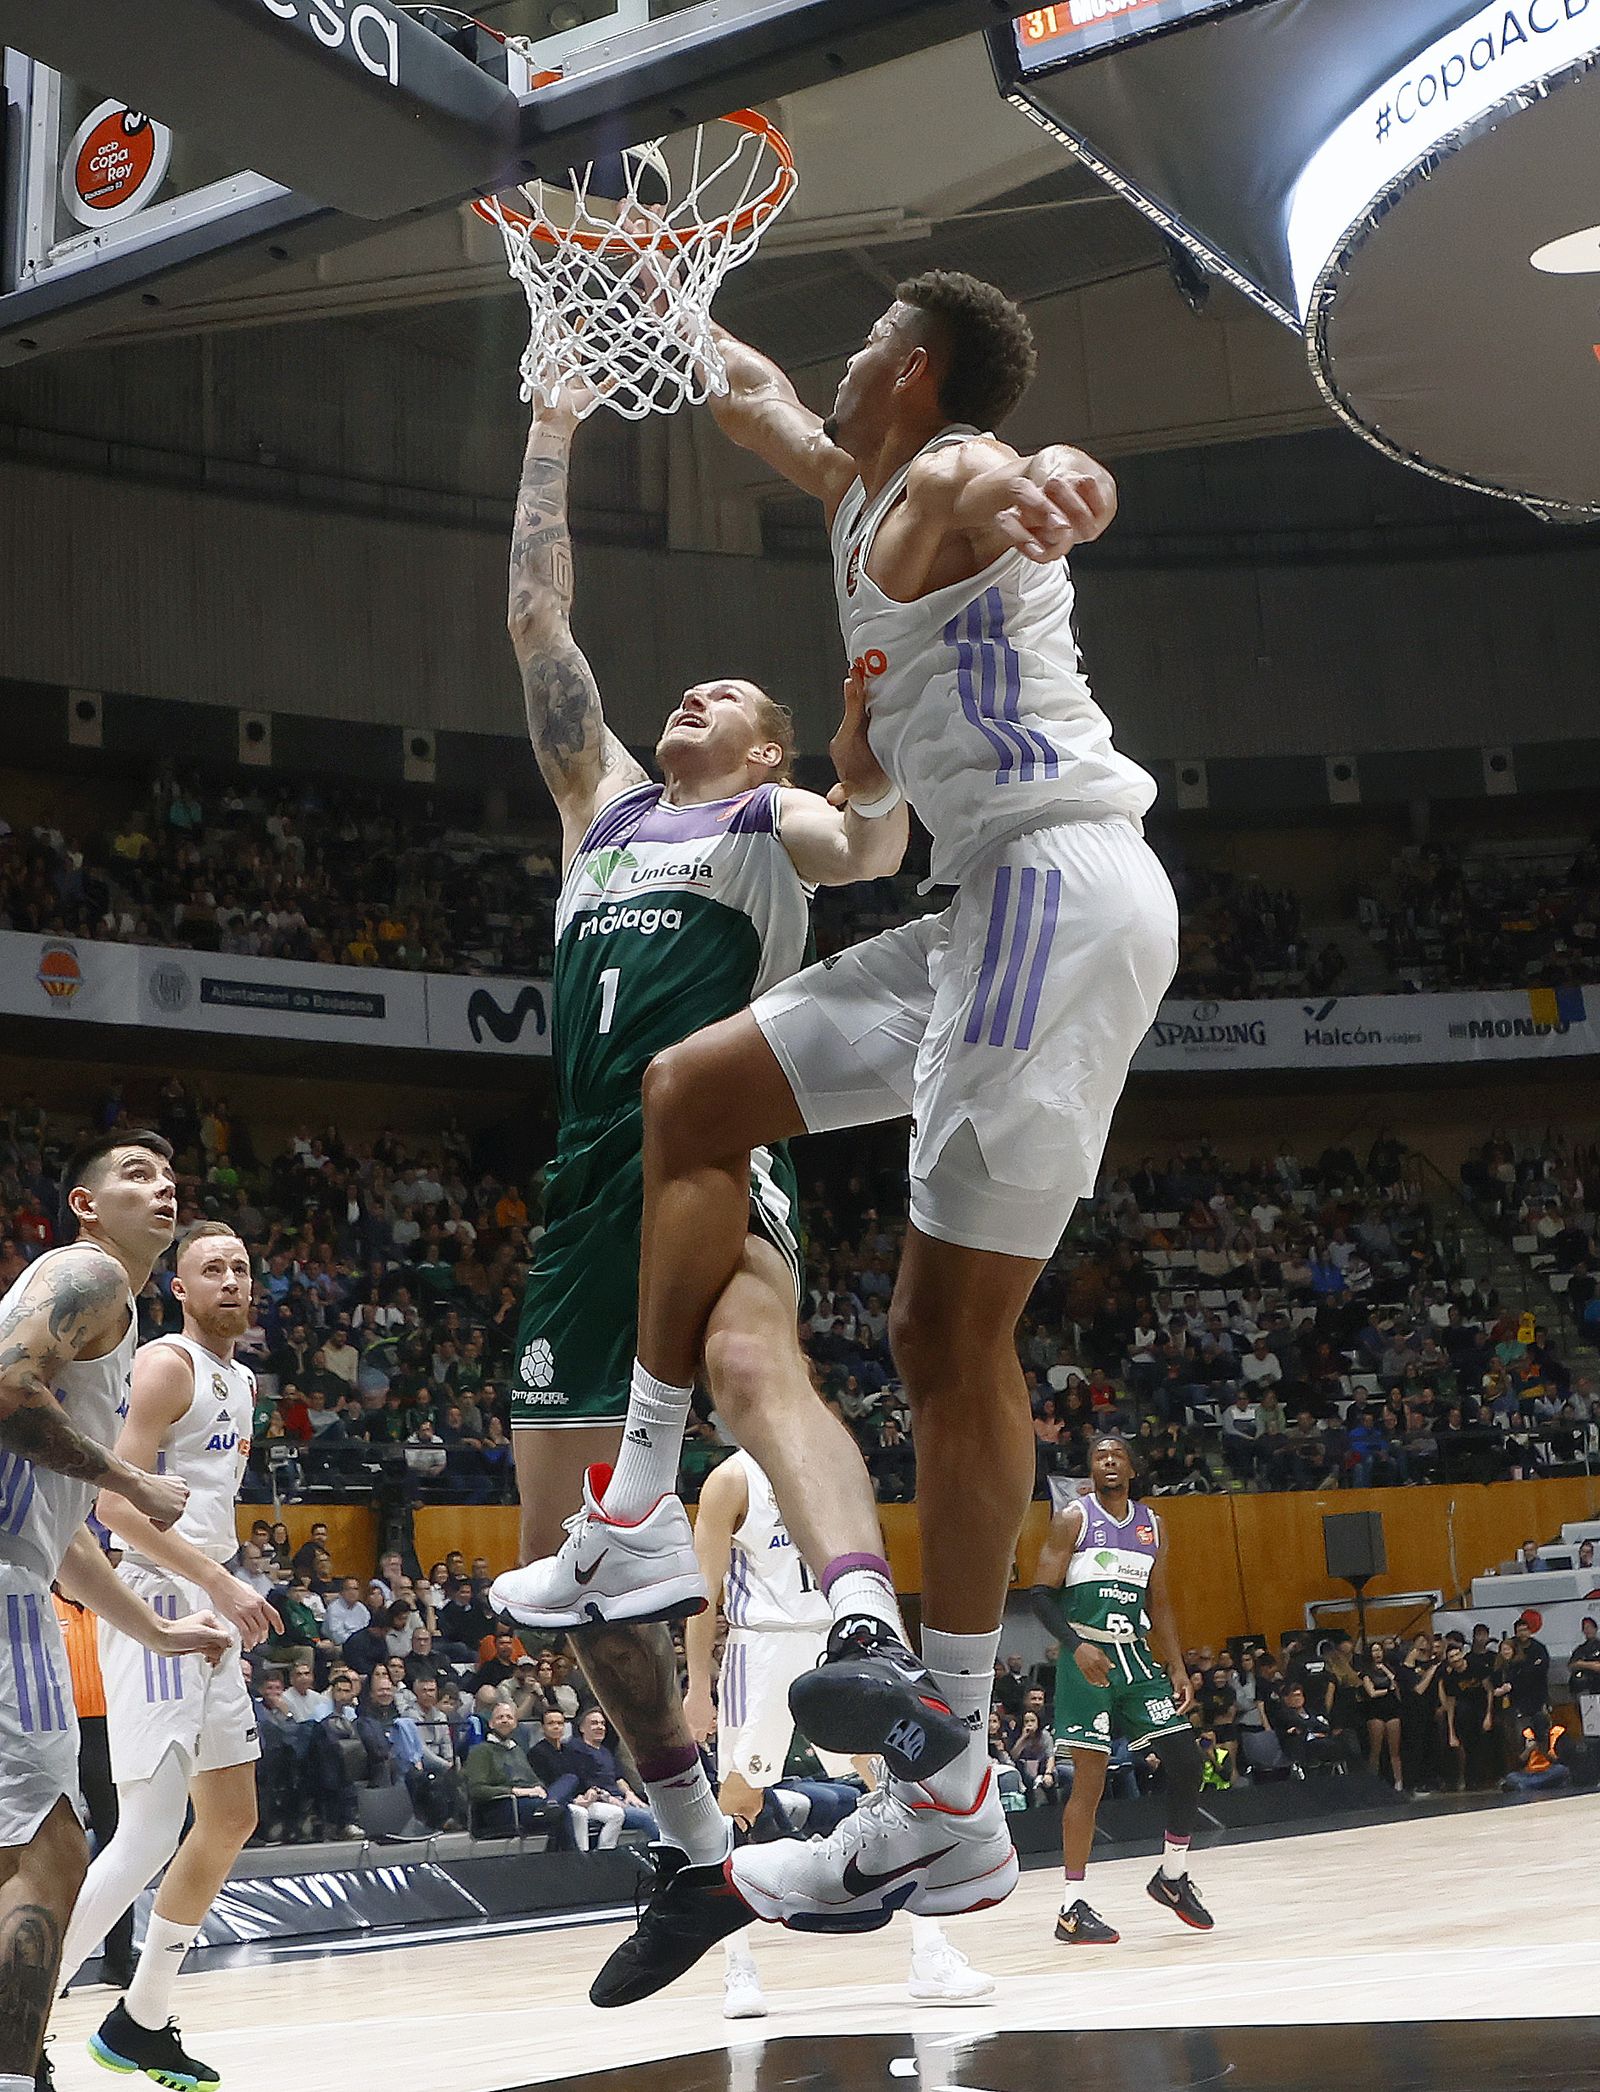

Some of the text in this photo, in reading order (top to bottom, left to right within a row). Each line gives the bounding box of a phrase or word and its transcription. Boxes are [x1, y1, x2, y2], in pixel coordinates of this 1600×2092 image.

[1027, 7, 1058, 39] 31
[263, 0, 398, 86] sa
[89, 148, 128, 171] Copa
[108, 163, 133, 181] Rey
[631, 857, 713, 884] Unicaja
[598, 968, 621, 1034] 1
[1153, 1020, 1267, 1047] SPALDING
[1304, 1026, 1381, 1046] Halcón
[1107, 1613, 1134, 1635] 55
